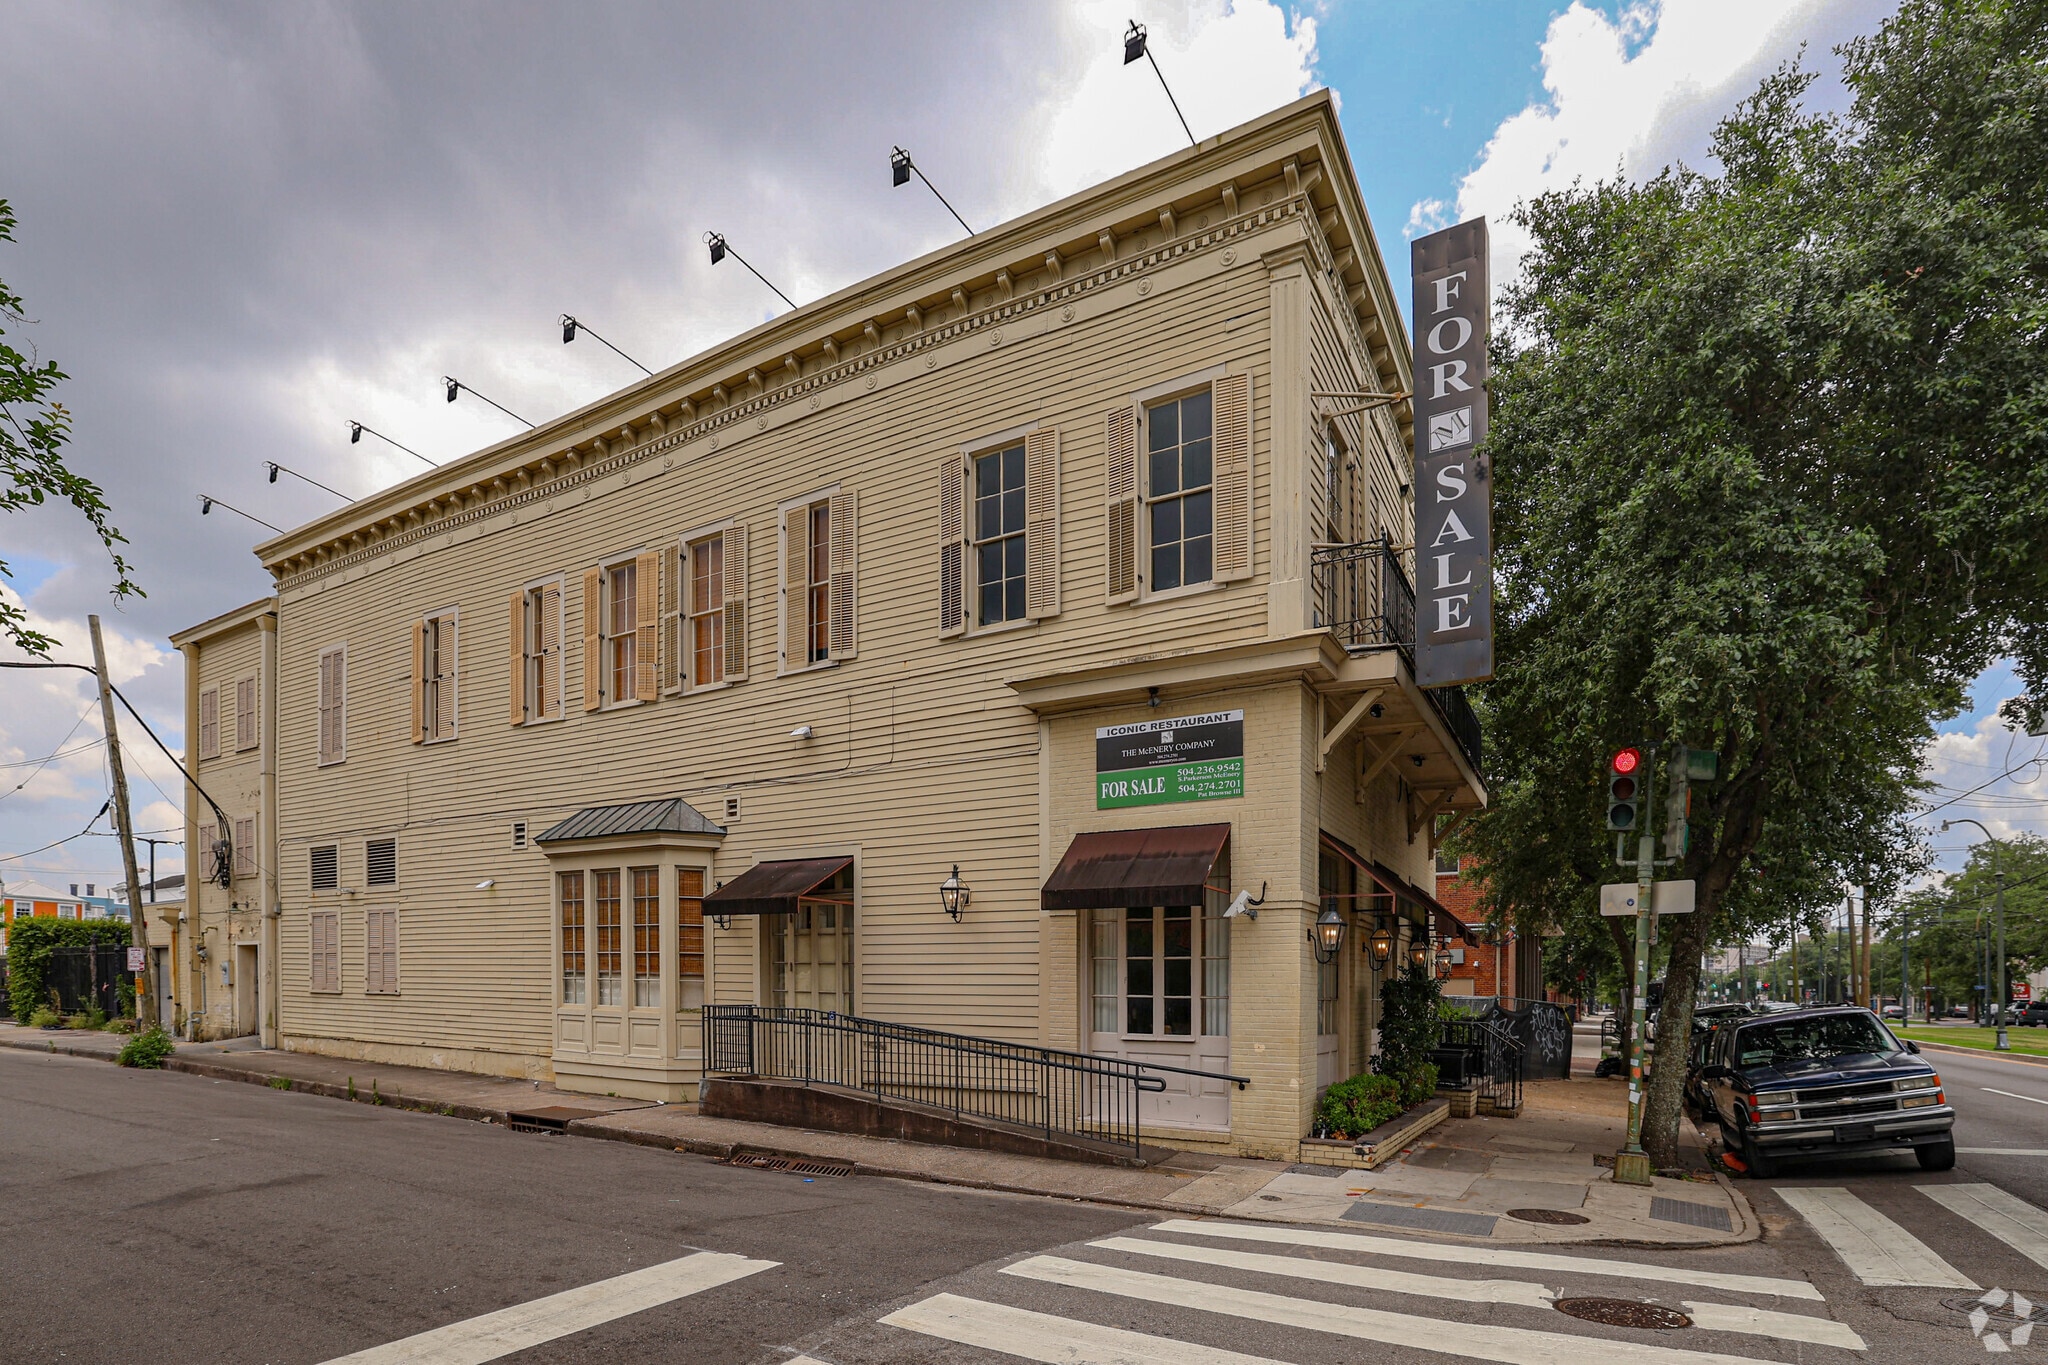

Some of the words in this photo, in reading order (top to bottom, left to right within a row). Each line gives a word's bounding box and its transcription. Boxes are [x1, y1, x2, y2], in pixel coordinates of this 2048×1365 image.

[1427, 270, 1474, 401] FOR
[1429, 462, 1474, 634] SALE
[1106, 724, 1147, 737] ICONIC
[1150, 713, 1231, 731] RESTAURANT
[1121, 748, 1137, 758] THE
[1138, 744, 1174, 756] McENERY
[1175, 739, 1216, 751] COMPANY
[1177, 762, 1241, 777] 504.236.9542
[1213, 771, 1241, 780] McEnery
[1101, 781, 1129, 799] FOR
[1131, 777, 1166, 797] SALE
[1177, 779, 1241, 794] 504.274.2701
[1208, 789, 1232, 797] Browne
